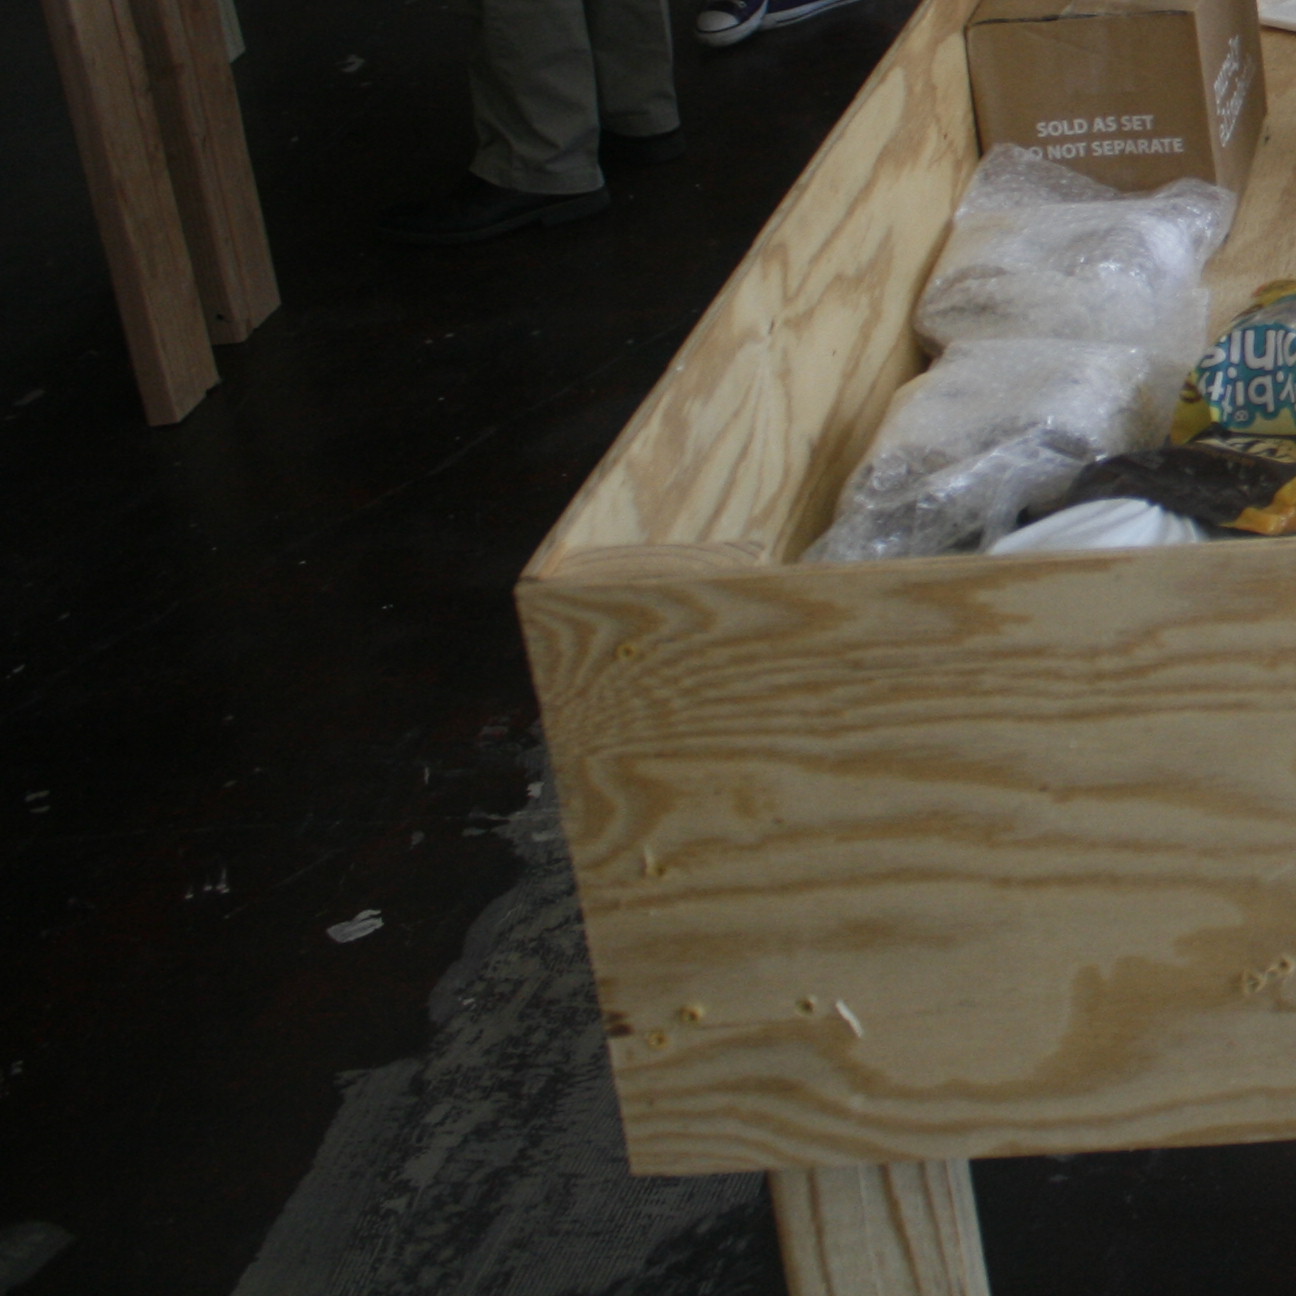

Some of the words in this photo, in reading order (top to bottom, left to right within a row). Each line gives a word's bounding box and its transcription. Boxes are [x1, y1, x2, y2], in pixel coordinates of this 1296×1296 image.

[1036, 118, 1087, 137] SOLD
[1092, 117, 1117, 133] AS
[1121, 115, 1155, 132] SET
[1047, 142, 1088, 159] NOT
[1092, 137, 1185, 156] SEPARATE
